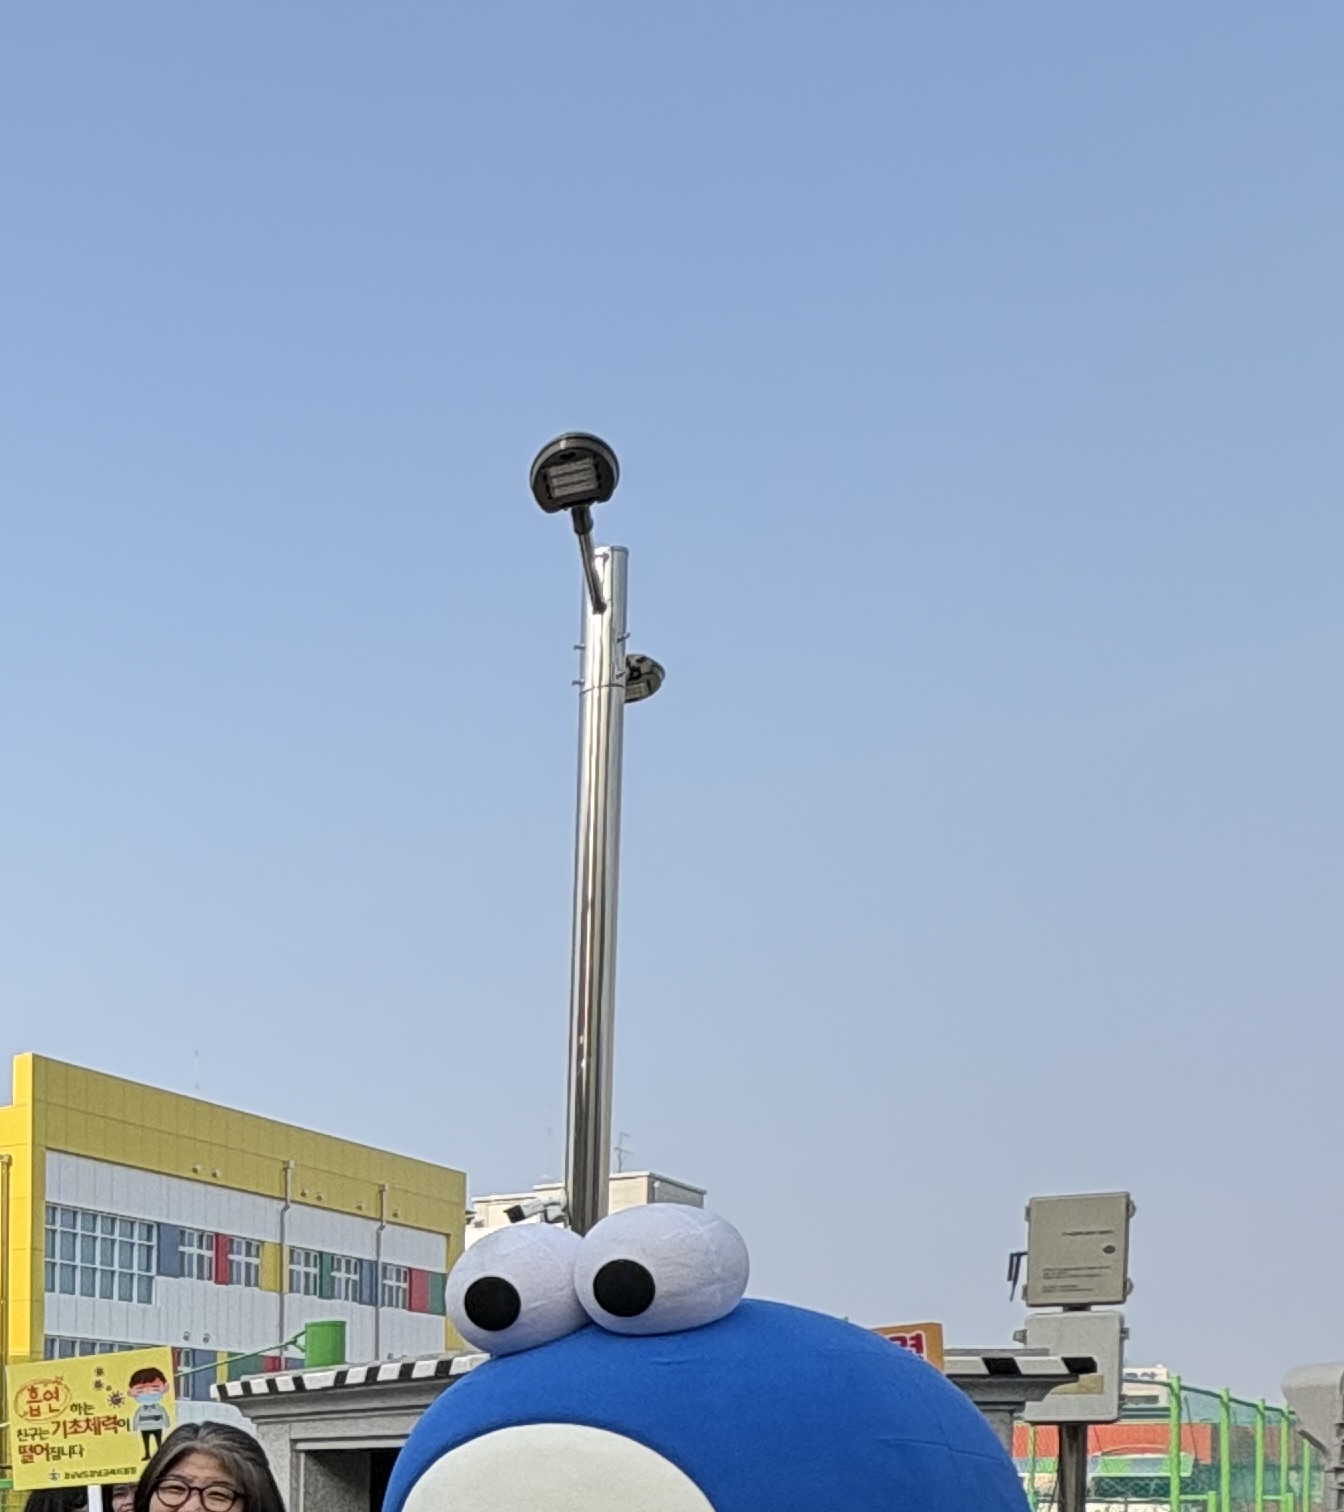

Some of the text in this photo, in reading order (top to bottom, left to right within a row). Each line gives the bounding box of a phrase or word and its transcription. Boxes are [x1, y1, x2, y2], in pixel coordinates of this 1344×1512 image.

[25, 1385, 96, 1418] 흡연 하는
[16, 1413, 132, 1442] 친구는 기초체력이
[17, 1442, 86, 1465] 떨어집니다
